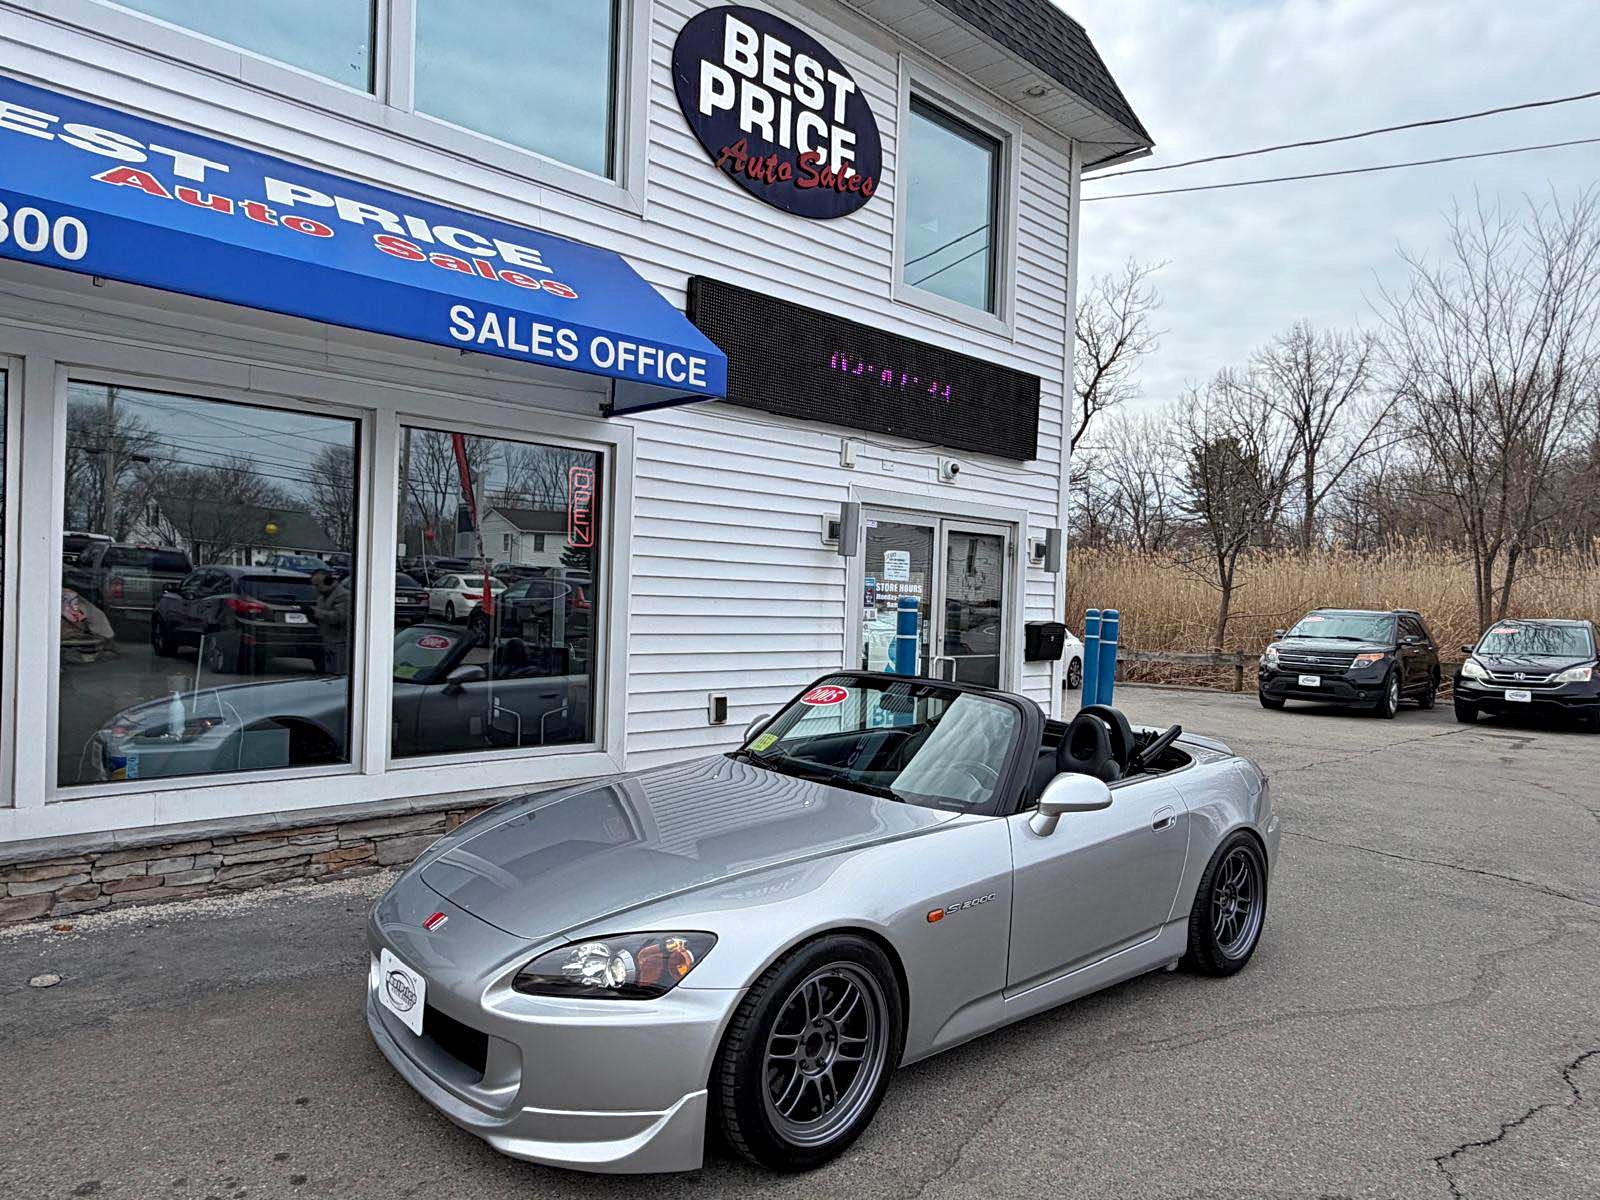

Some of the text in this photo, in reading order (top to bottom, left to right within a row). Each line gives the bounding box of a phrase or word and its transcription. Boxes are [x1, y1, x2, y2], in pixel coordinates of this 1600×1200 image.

[724, 13, 855, 125] BEST
[699, 59, 856, 179] PRICE
[715, 138, 874, 197] Auto Sales
[0, 201, 88, 261] 00
[90, 165, 579, 299] Auto Sales
[264, 176, 554, 274] PRICE
[449, 305, 707, 387] SALES OFFICE
[574, 473, 591, 543] OPEN
[875, 582, 923, 594] STORE HOURS
[945, 893, 996, 915] S2000
